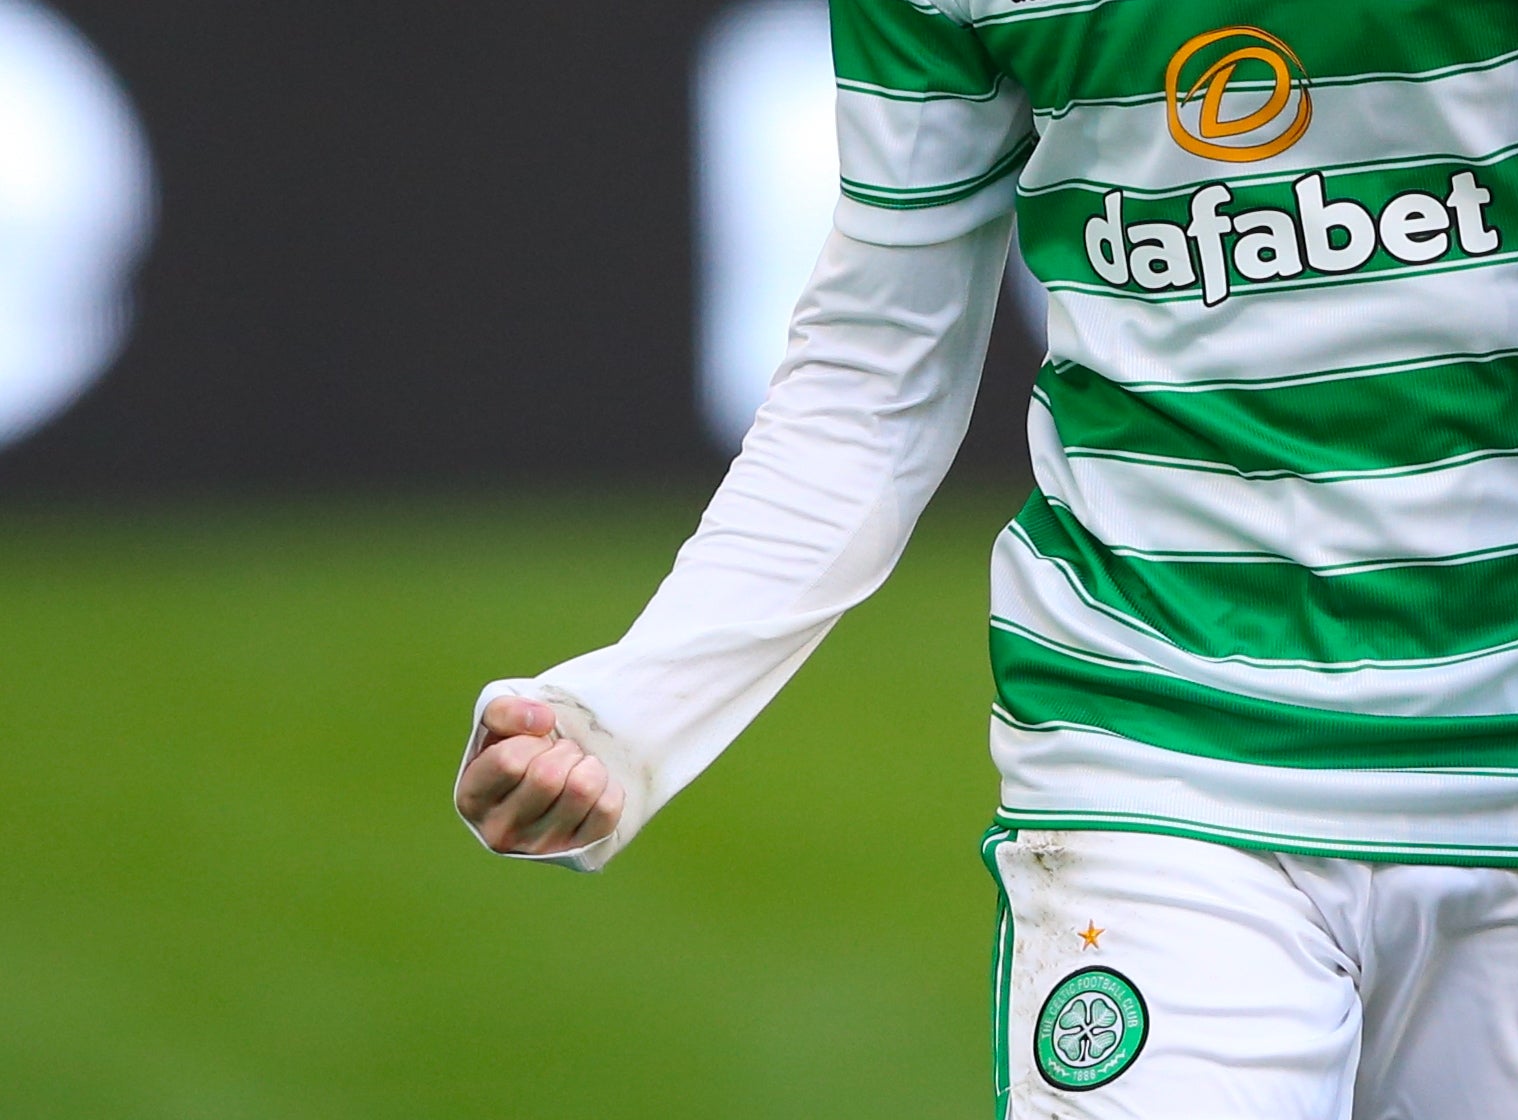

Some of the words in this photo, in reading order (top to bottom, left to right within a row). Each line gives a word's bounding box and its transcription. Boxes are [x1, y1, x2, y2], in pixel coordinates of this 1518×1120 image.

[1083, 170, 1500, 308] dafabet
[1050, 983, 1076, 1016] CELTIC
[1078, 976, 1126, 1000] FOOTBALL
[1123, 998, 1139, 1028] CLUB
